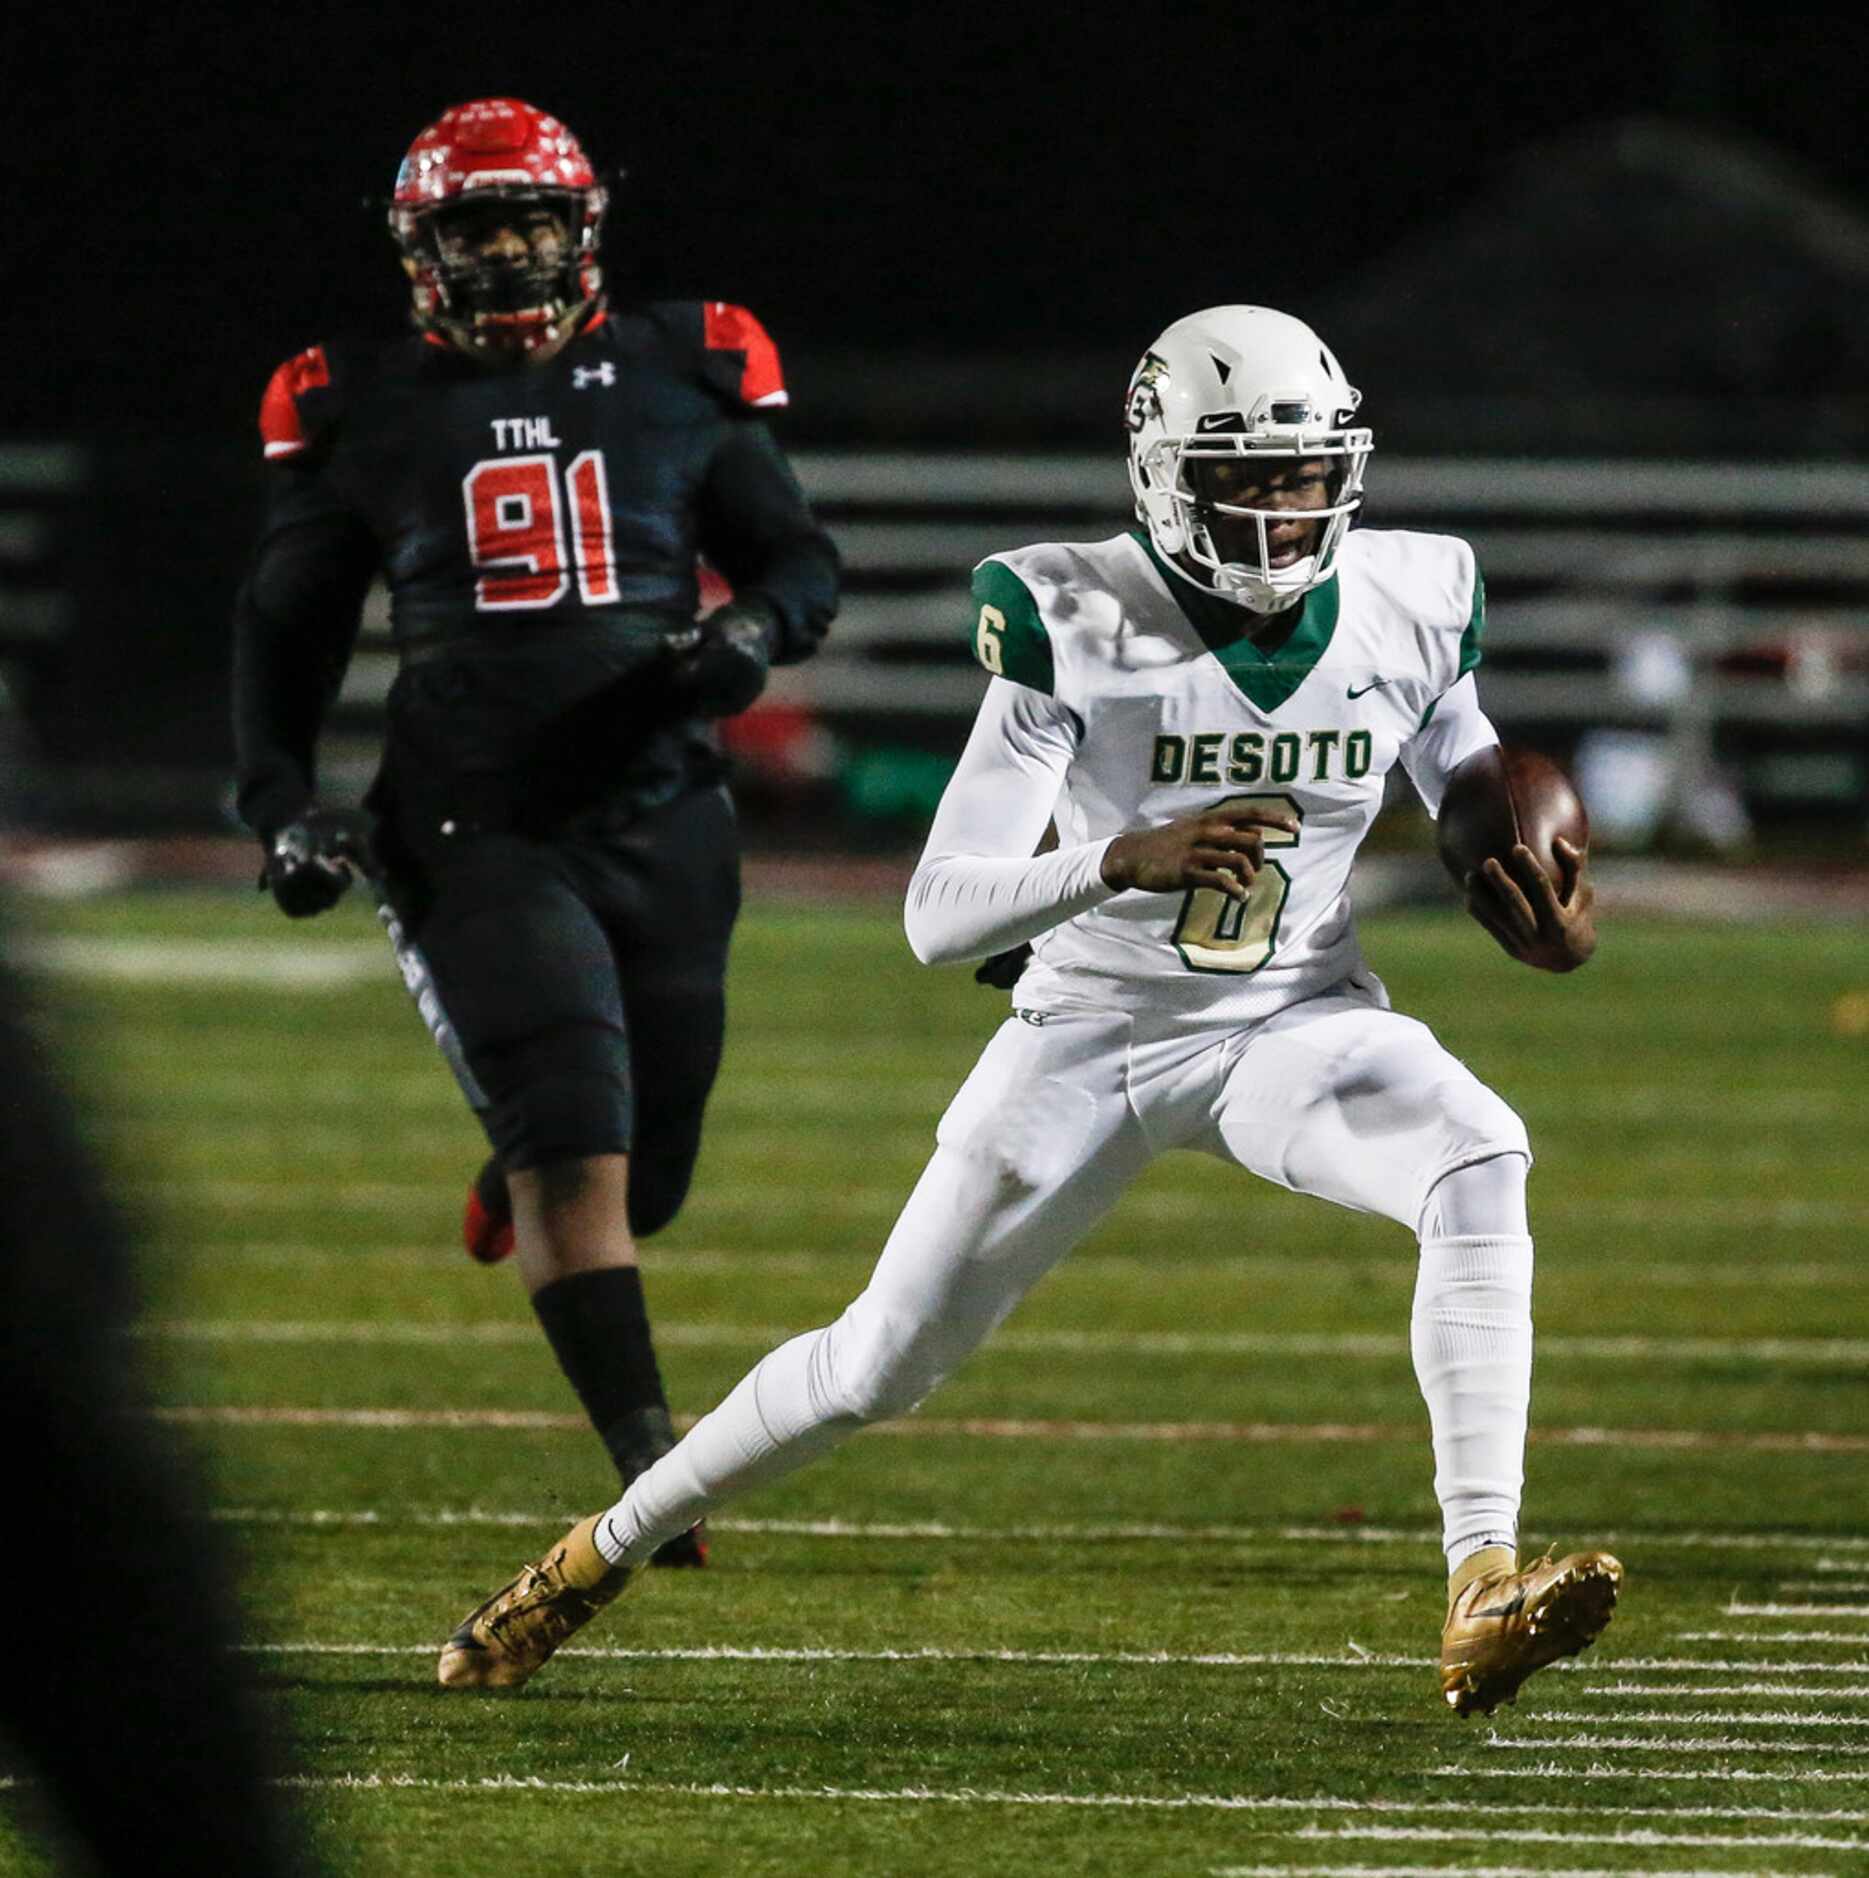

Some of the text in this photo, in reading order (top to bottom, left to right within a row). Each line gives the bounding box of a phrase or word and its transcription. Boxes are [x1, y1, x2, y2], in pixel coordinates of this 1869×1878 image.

[490, 416, 562, 450] TTHL
[462, 450, 621, 611] 91
[977, 603, 1006, 676] 6
[1151, 729, 1373, 786] DESOTO
[1170, 793, 1304, 975] 6
